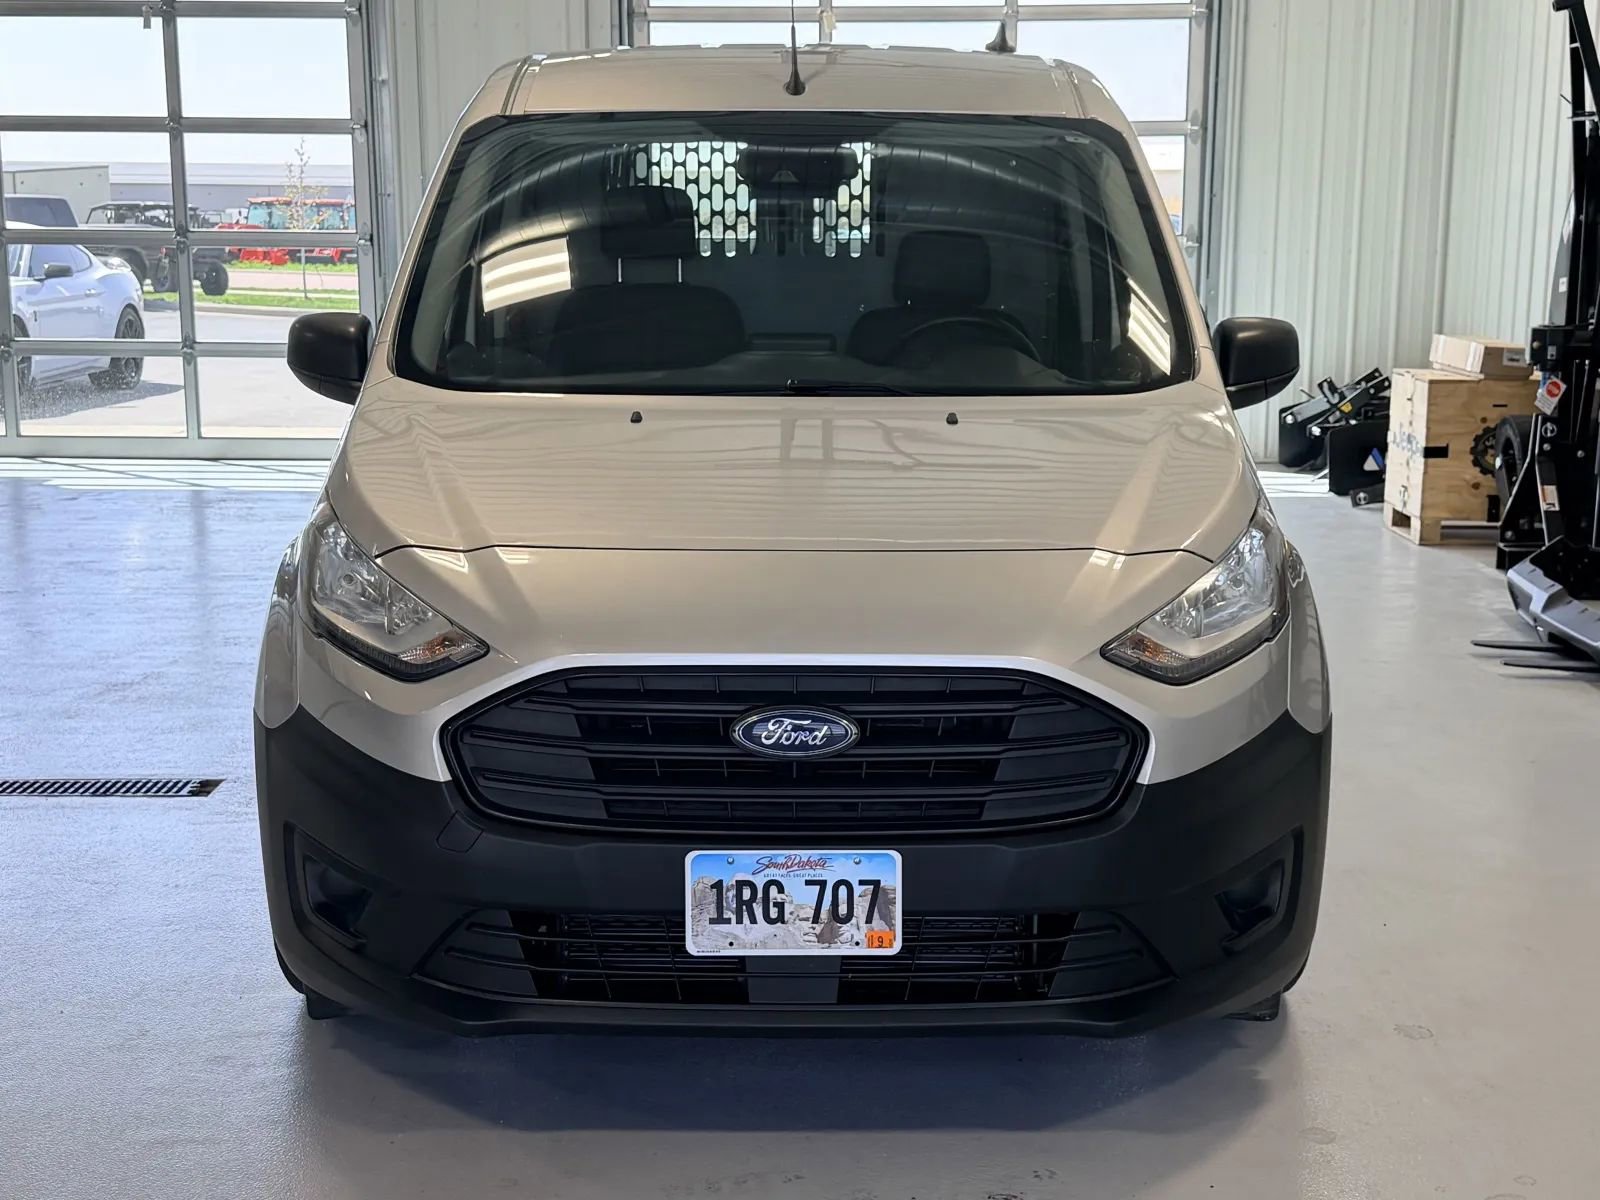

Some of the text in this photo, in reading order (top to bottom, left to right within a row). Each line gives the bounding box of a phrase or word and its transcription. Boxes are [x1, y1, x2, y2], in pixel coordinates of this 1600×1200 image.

[761, 718, 828, 745] Ford
[752, 854, 835, 875] South Dakota
[709, 879, 881, 925] 1RG 707
